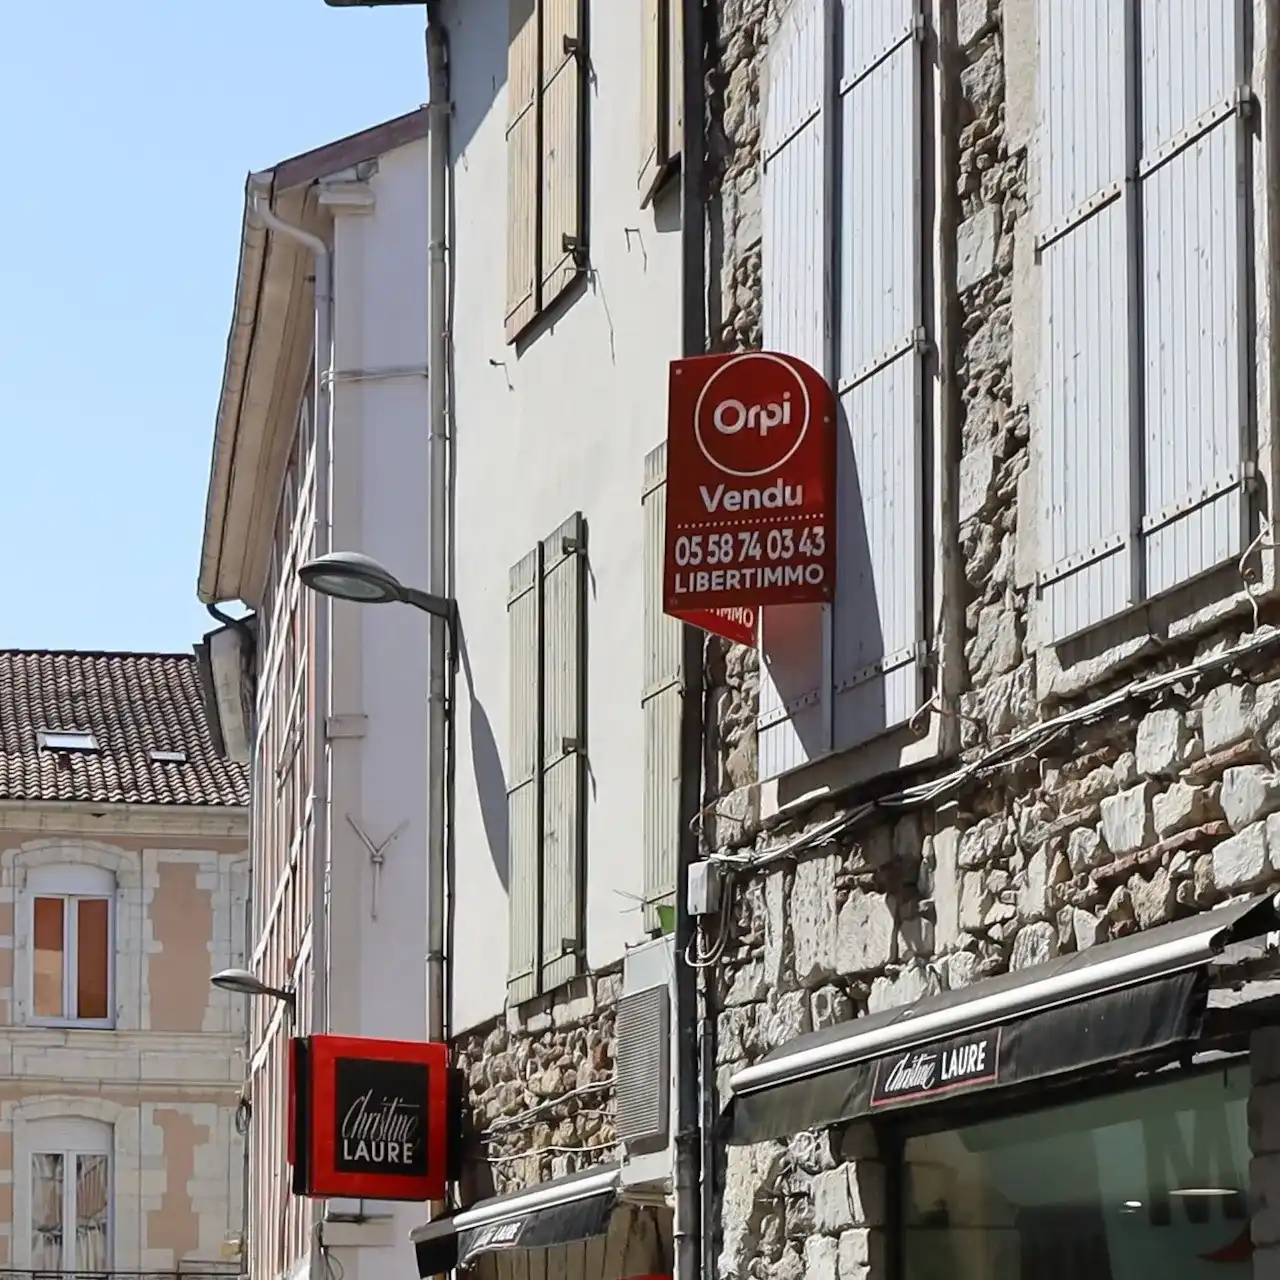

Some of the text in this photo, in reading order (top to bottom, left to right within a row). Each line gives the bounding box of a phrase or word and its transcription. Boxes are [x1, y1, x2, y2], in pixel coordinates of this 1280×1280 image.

[713, 391, 791, 437] Orpi
[699, 478, 803, 513] Vendu
[675, 525, 826, 567] 05 58 74 03 43
[674, 563, 824, 594] LIBERTIMMO
[941, 1040, 988, 1080] LAURE
[343, 1138, 413, 1164] LAURE
